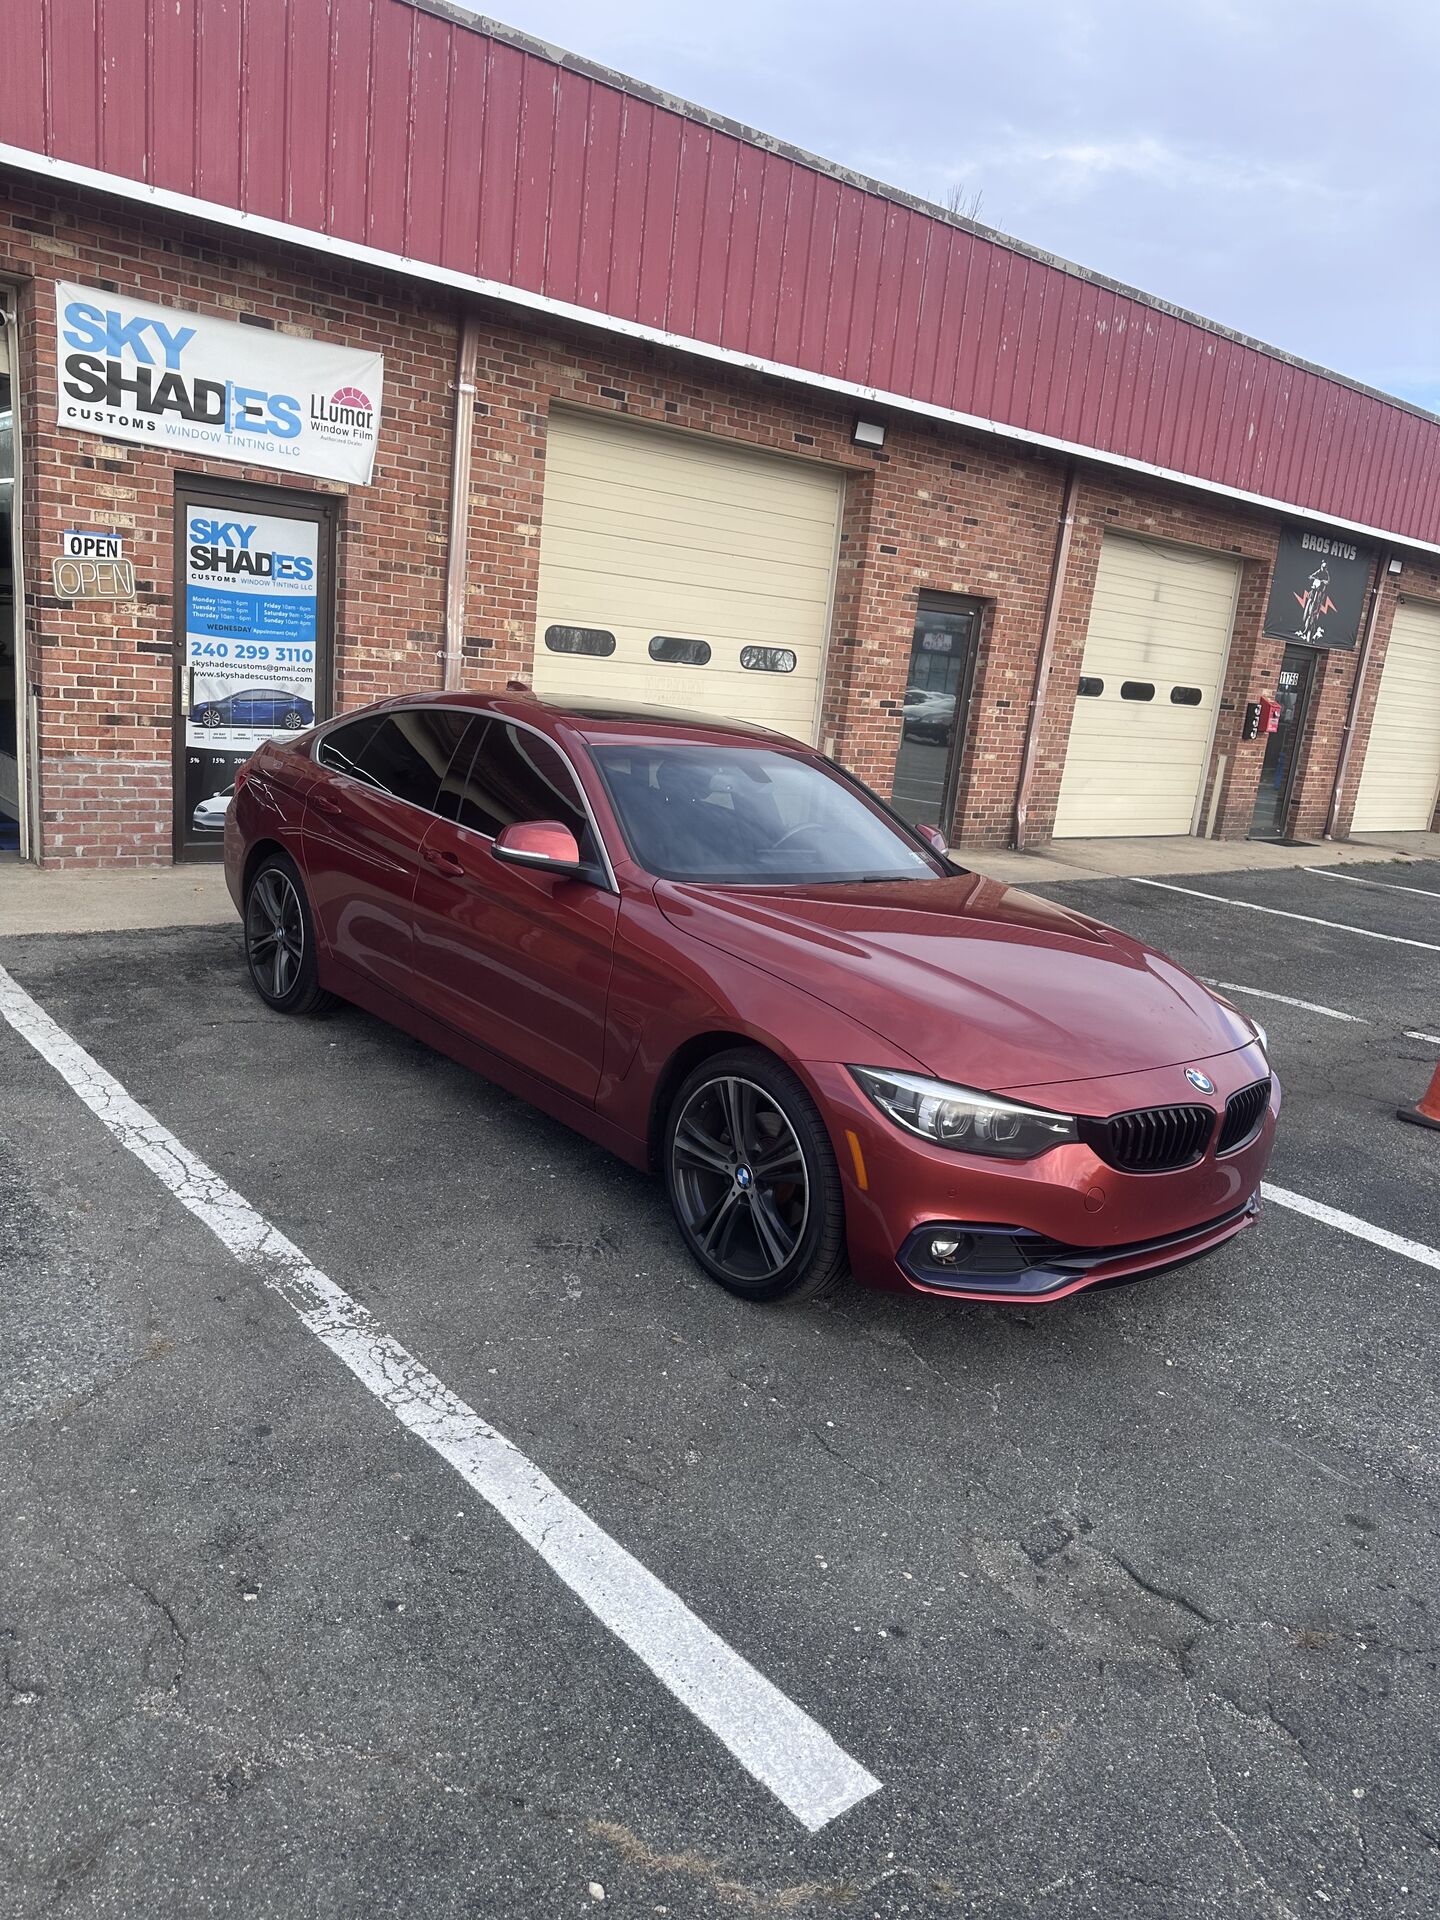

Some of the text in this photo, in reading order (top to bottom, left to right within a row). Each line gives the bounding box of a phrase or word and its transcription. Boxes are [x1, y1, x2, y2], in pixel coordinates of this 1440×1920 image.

[63, 302, 197, 370] SKY
[63, 353, 302, 439] SHADES
[67, 406, 301, 457] CUSTOMS WINDOW TINTING LLC
[310, 420, 373, 441] Window Film
[189, 518, 257, 549] SKY
[71, 536, 118, 558] OPEN
[1301, 533, 1357, 561] BROS ATVS
[189, 545, 314, 581] SHADES
[58, 563, 130, 594] OPEN
[191, 573, 313, 591] CUSTOMS WINDOW TINTING LLC
[192, 596, 216, 604] Monday
[192, 603, 217, 612] Tuesday
[263, 602, 281, 611] Friday
[192, 611, 219, 620] Thursday
[263, 609, 288, 618] Saturday
[263, 617, 284, 625] Sunday
[206, 624, 251, 632] WEDNESDAY
[191, 641, 313, 663] 240 299 3110
[191, 660, 313, 673] skyshadescustoms@gmail.com
[193, 671, 313, 683] www.skyshadescustoms.com
